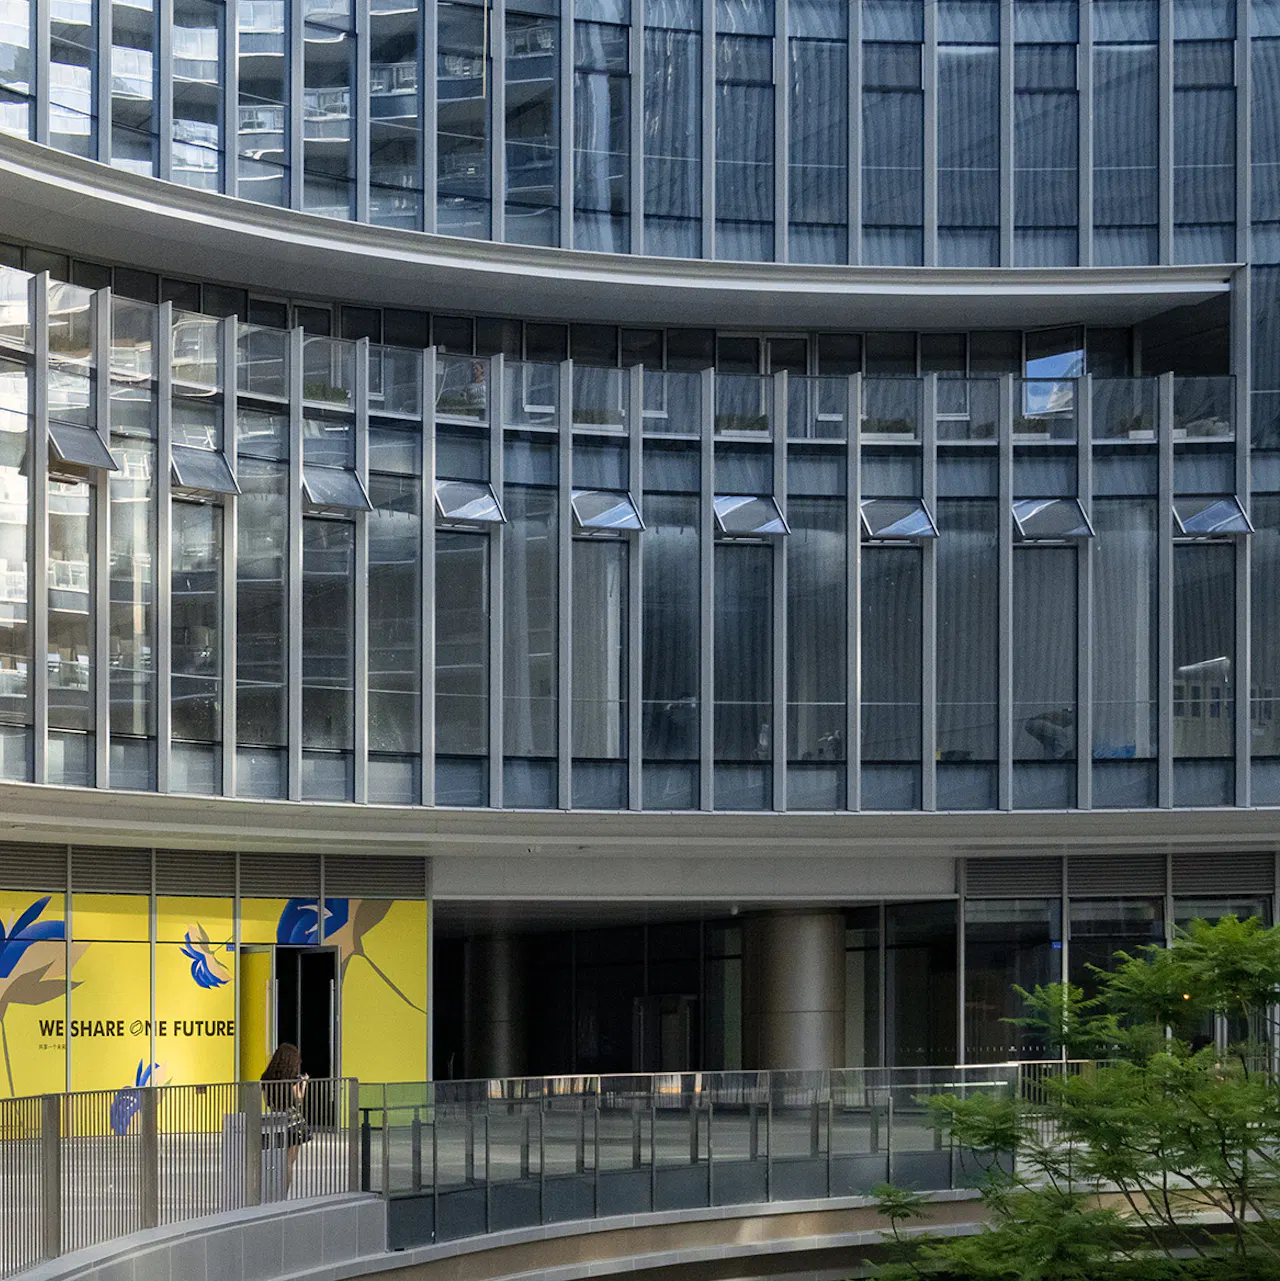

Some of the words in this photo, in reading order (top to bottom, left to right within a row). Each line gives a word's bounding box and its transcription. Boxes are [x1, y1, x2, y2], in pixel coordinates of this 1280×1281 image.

[39, 1020, 64, 1037] WE
[70, 1020, 125, 1038] SHARE
[174, 1020, 235, 1037] FUTURE
